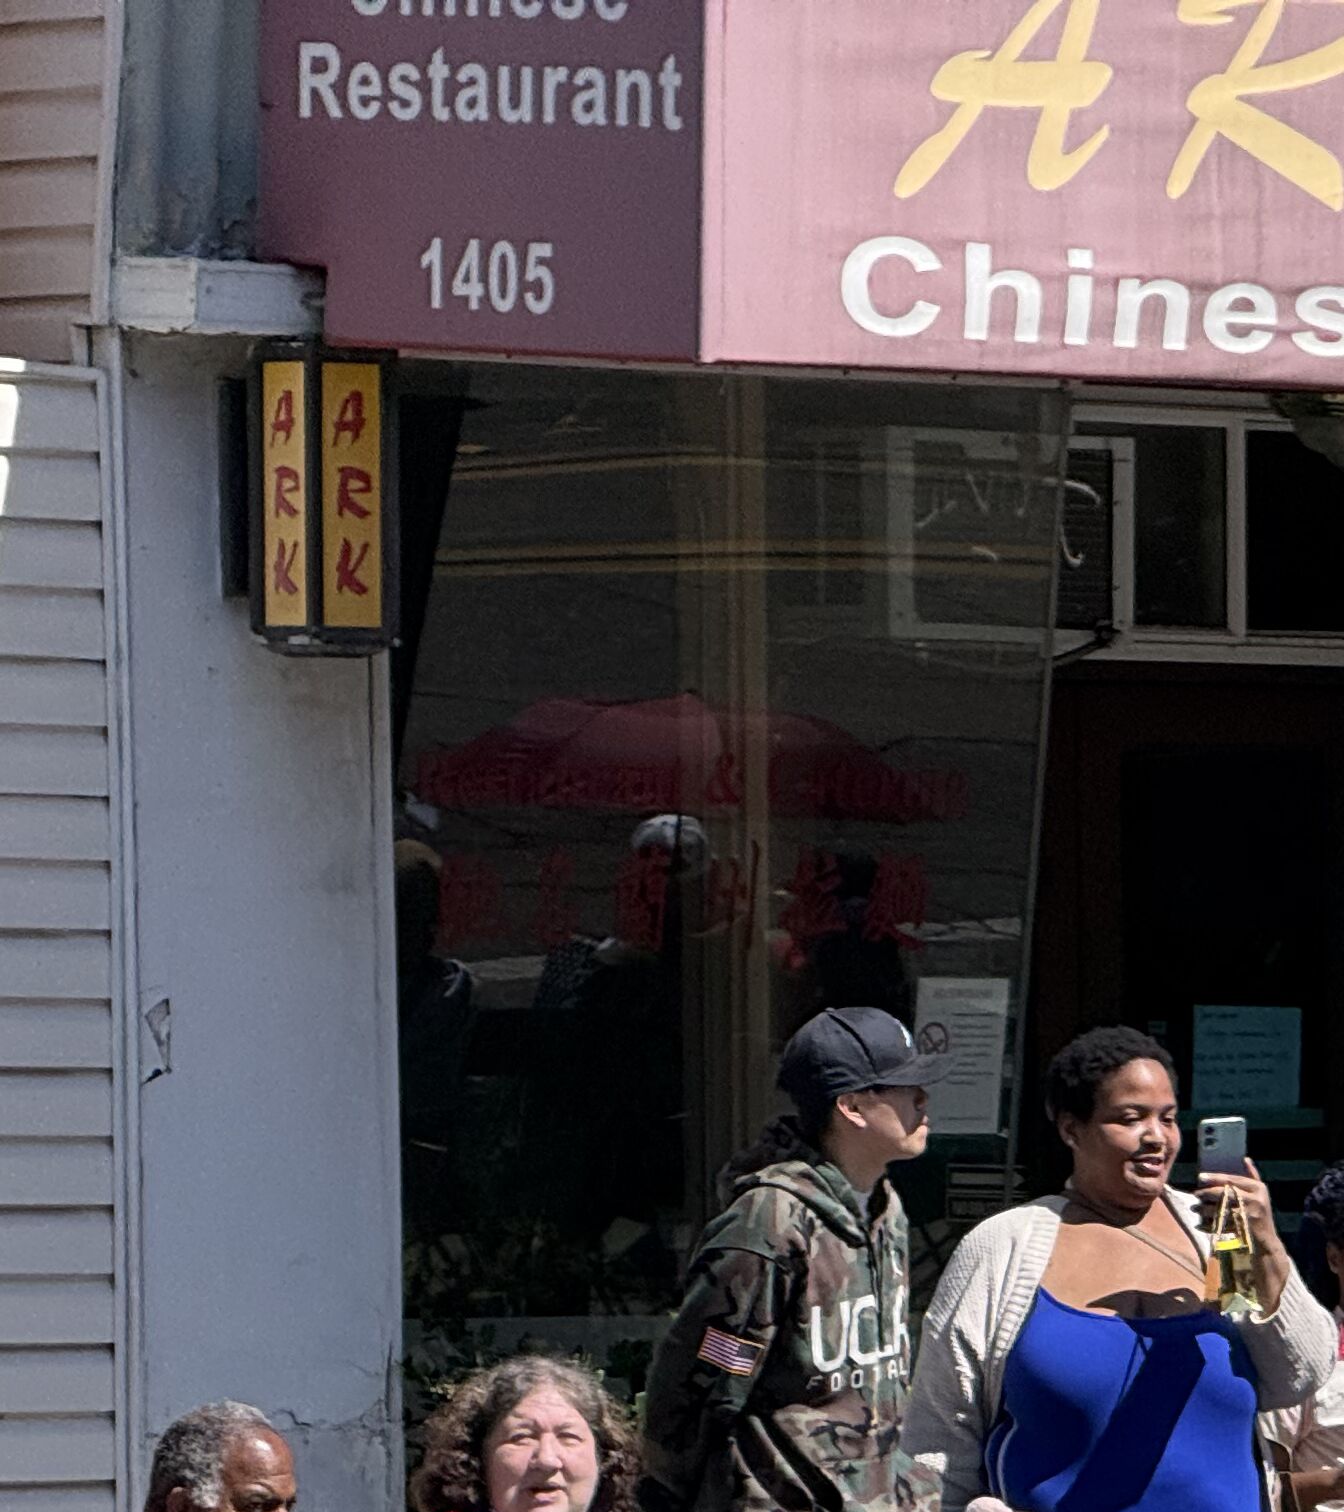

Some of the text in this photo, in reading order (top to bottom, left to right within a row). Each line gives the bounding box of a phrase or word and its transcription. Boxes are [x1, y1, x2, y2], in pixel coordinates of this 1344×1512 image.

[299, 42, 683, 131] Restaurant
[419, 237, 556, 315] 1405
[270, 389, 302, 597] ARK
[333, 388, 373, 597] ARK
